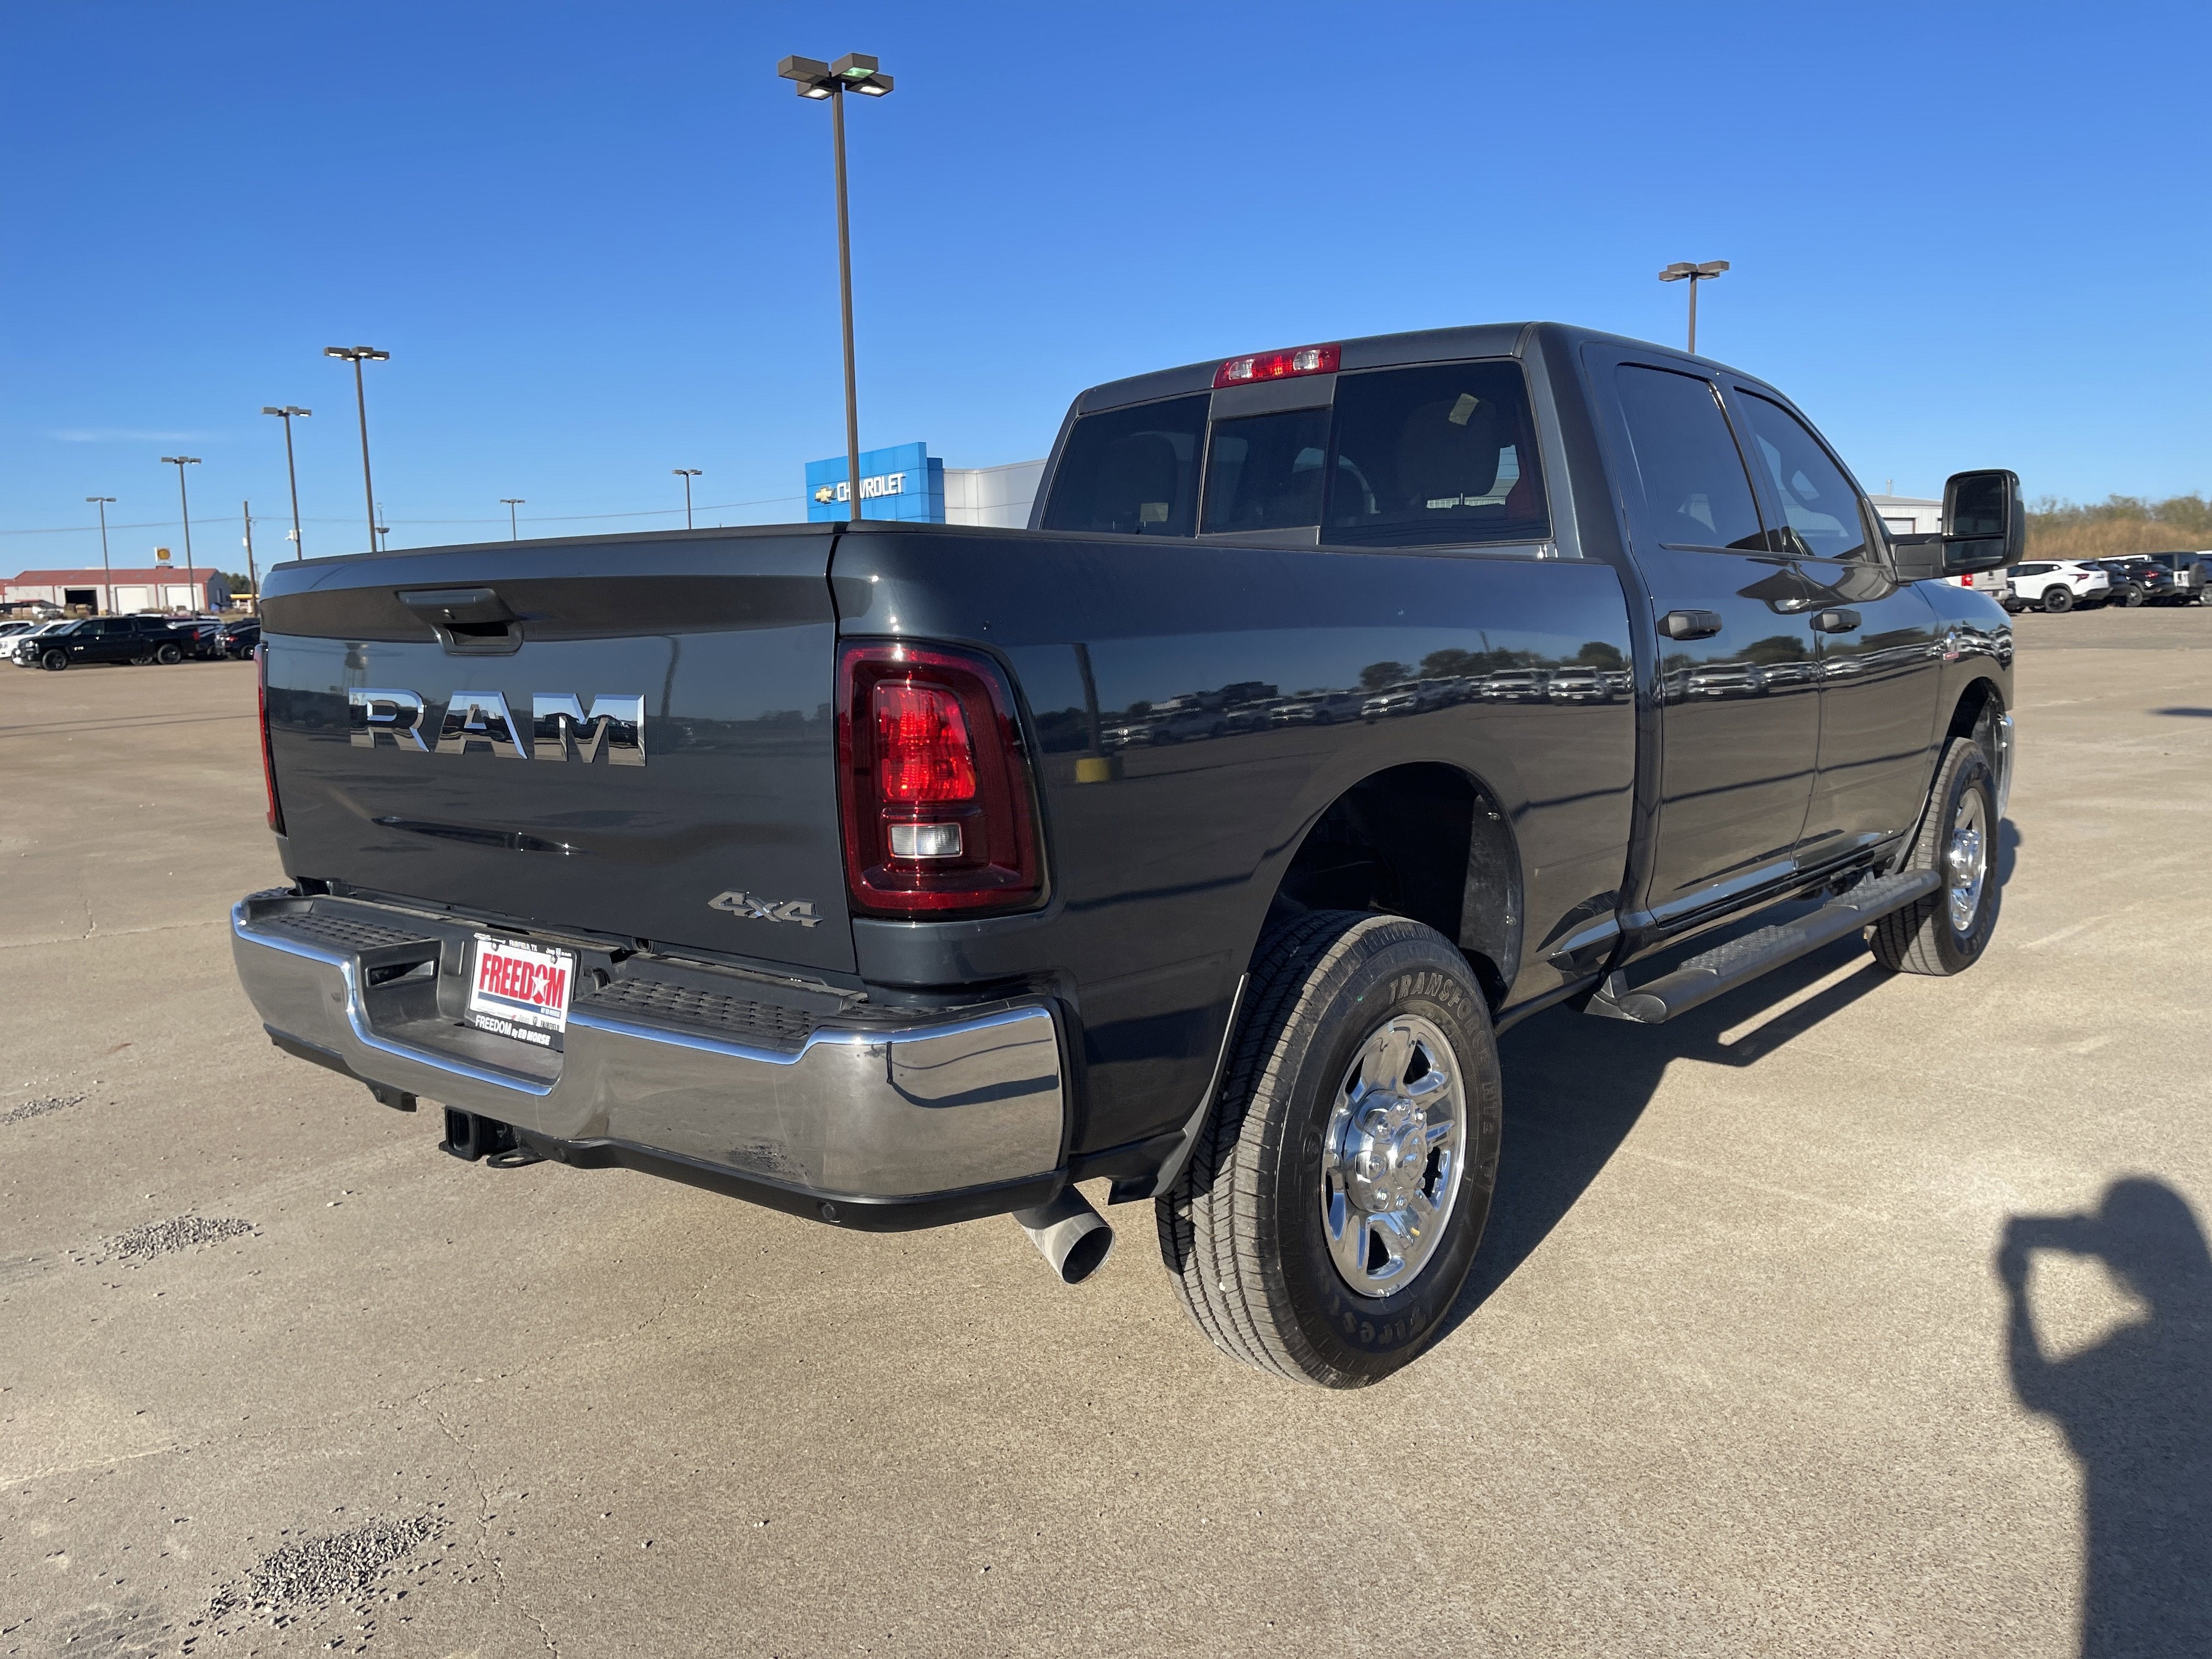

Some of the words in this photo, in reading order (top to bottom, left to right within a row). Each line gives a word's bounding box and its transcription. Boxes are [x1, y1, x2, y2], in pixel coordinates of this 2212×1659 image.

[837, 472, 904, 501] CHVROLET
[348, 687, 647, 767] RAM
[531, 944, 538, 952] TX
[478, 952, 566, 1009] FREEDOM
[475, 1014, 512, 1036] FREEDOM
[517, 1028, 527, 1040] ED
[526, 1030, 551, 1046] MORSE
[1389, 971, 1493, 1065] TRANSFORCE
